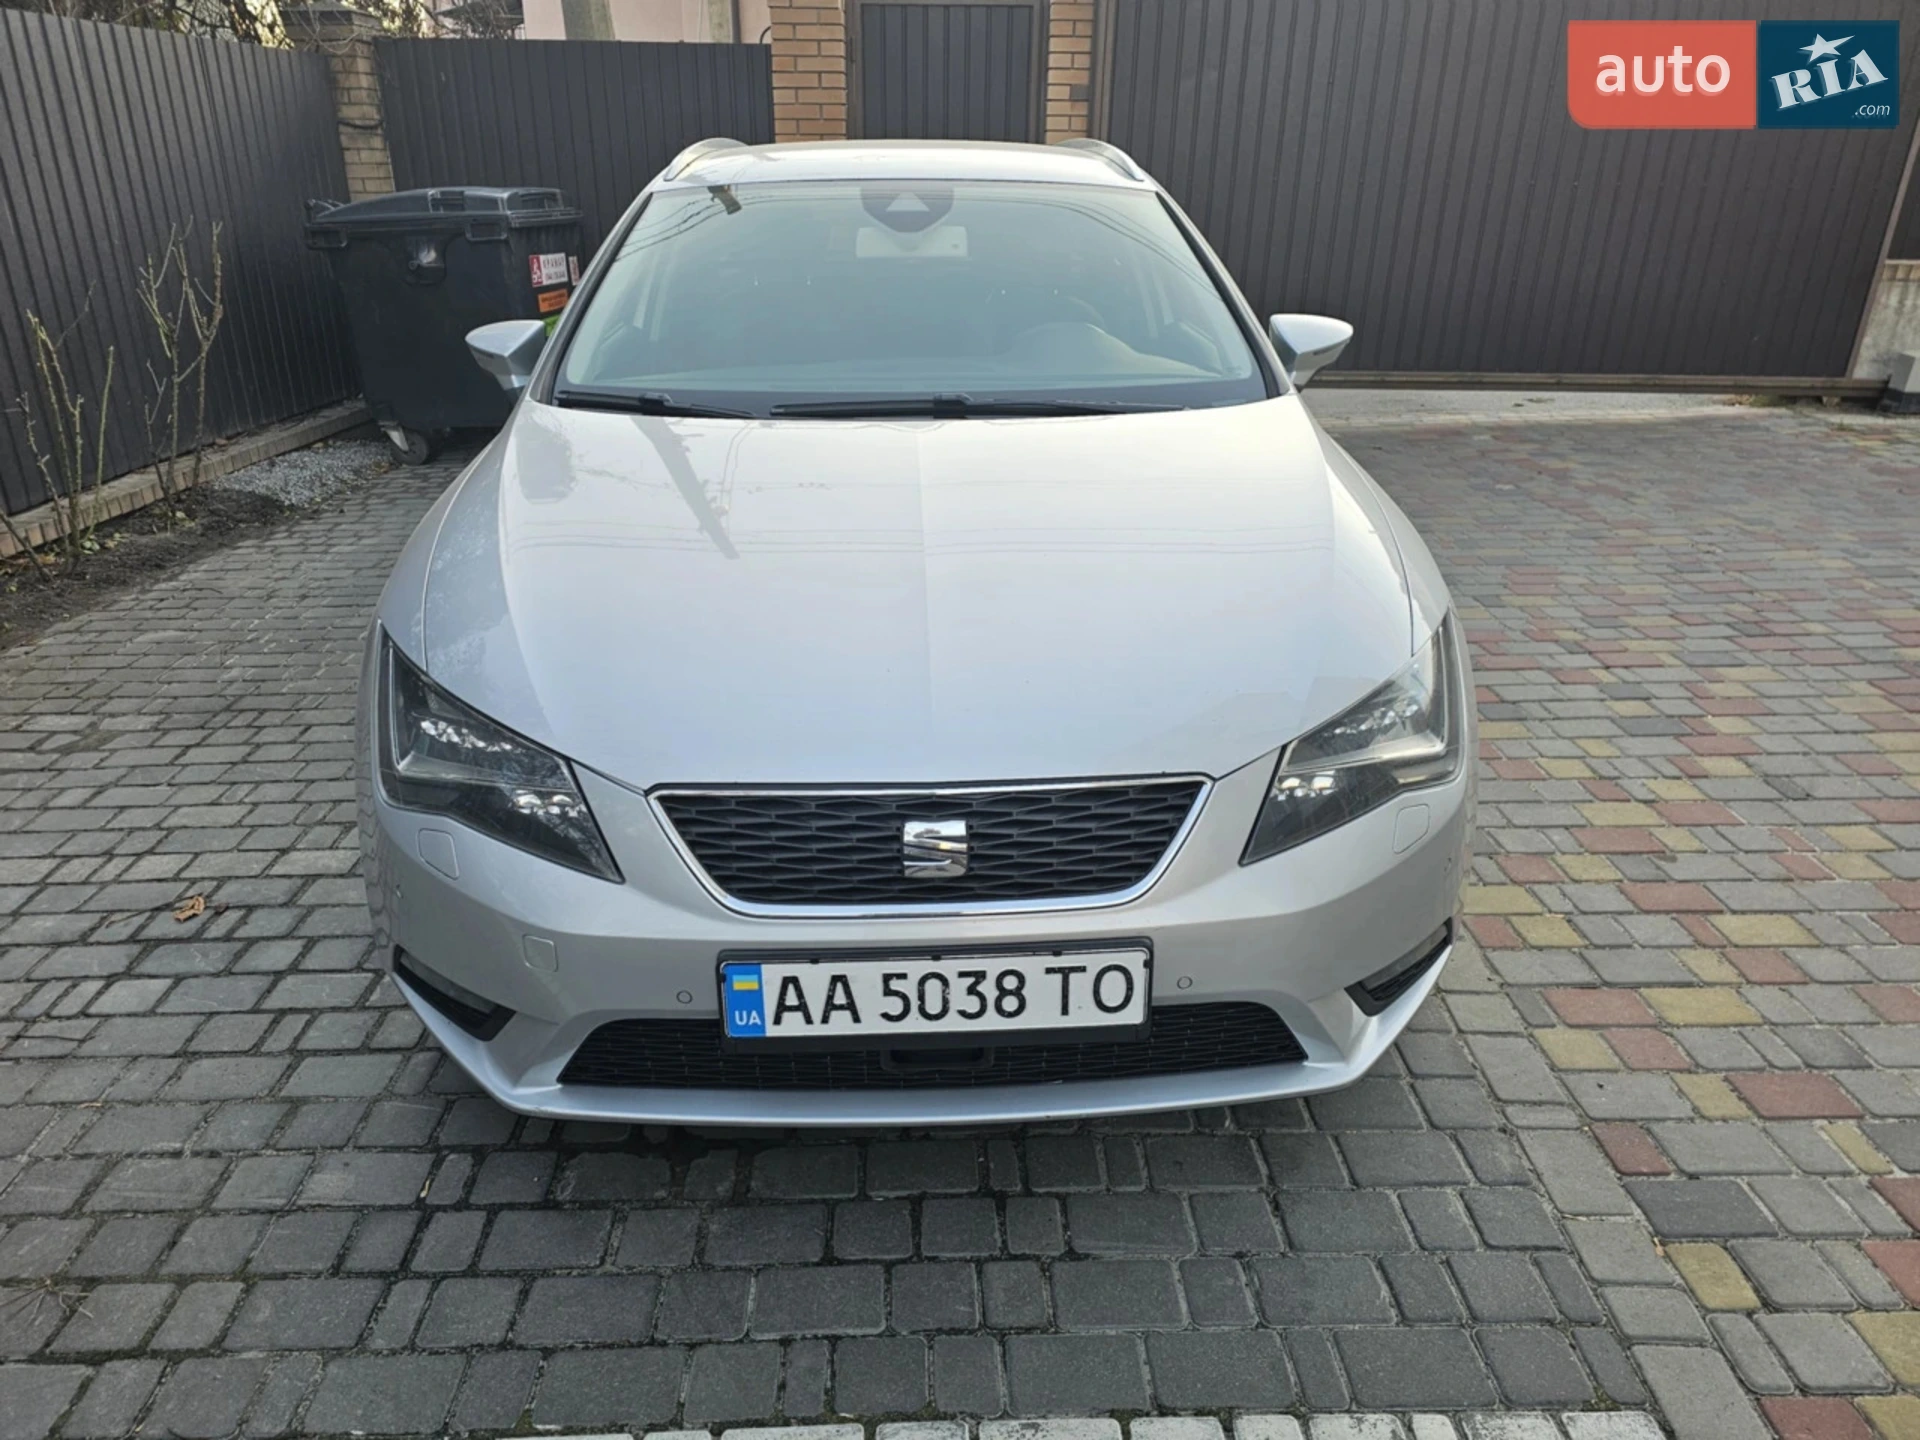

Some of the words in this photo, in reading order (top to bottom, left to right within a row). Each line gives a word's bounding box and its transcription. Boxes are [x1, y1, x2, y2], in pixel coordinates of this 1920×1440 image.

[772, 974, 862, 1026] AA
[880, 968, 1027, 1022] 5038
[1045, 963, 1135, 1017] TO
[735, 1012, 761, 1027] UA
